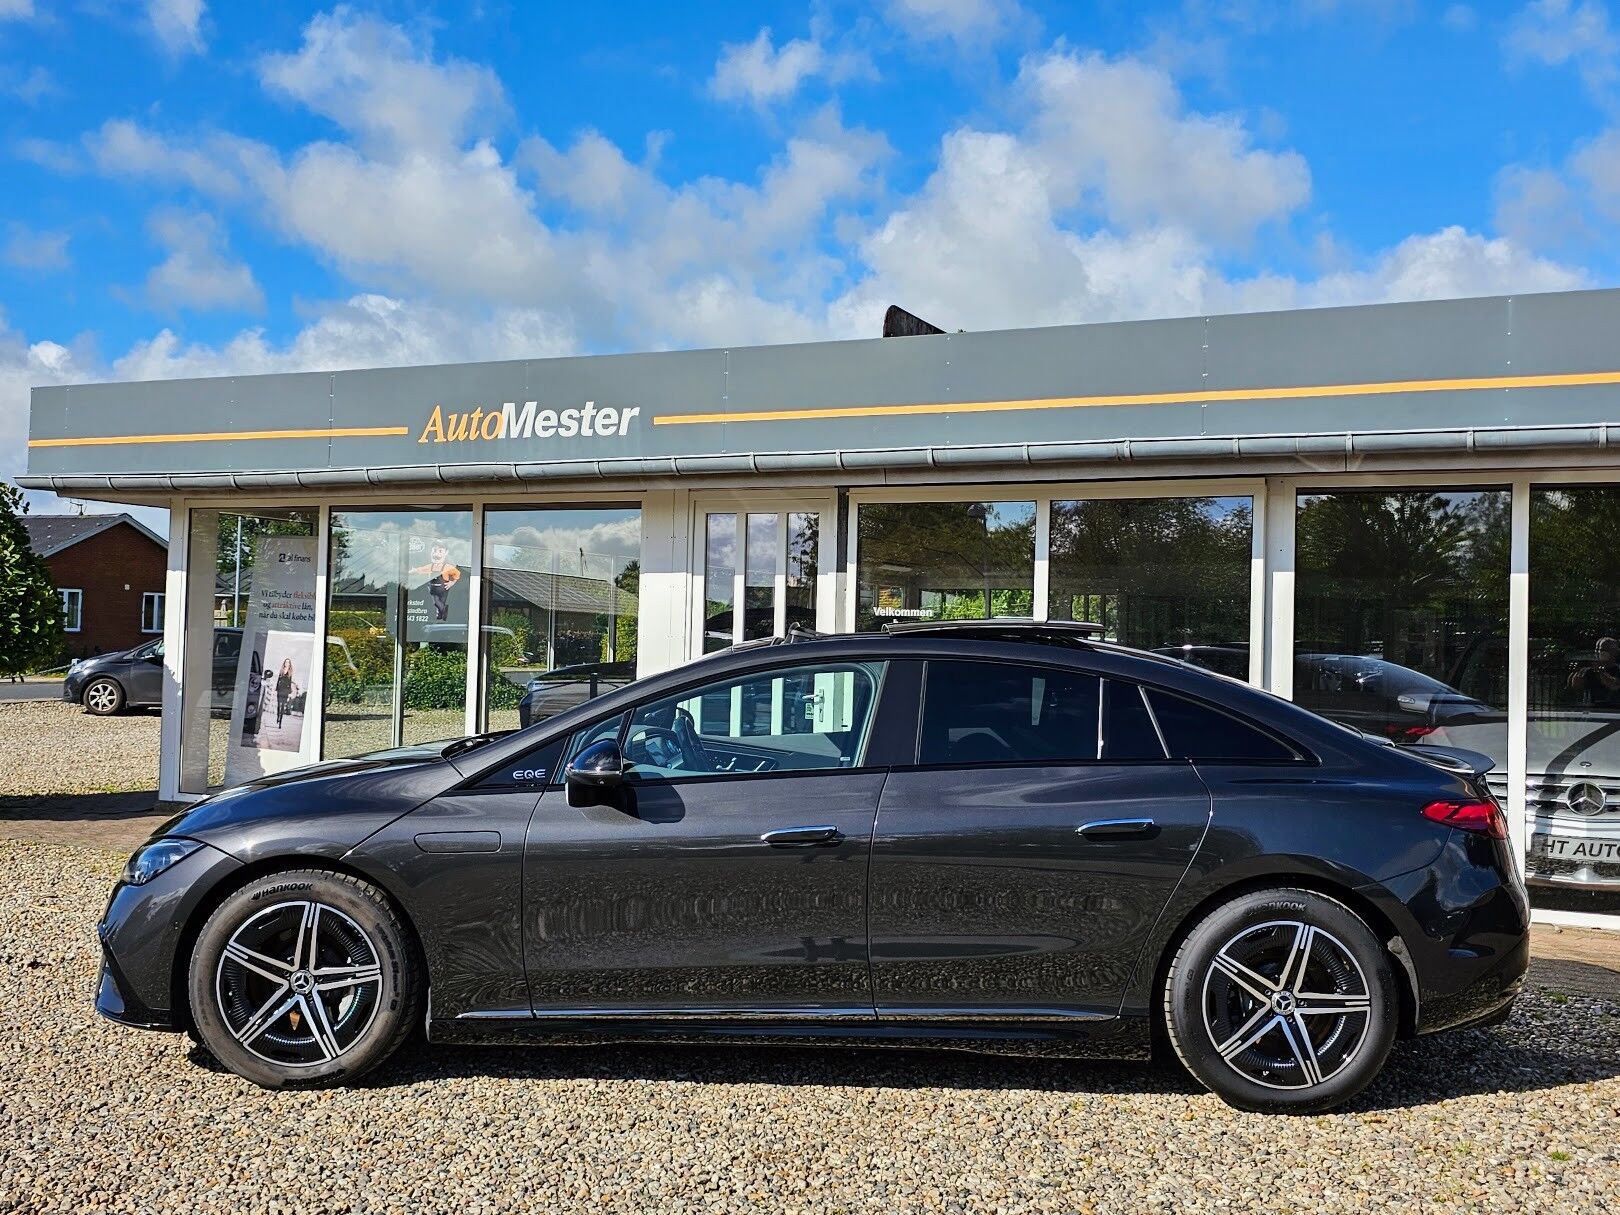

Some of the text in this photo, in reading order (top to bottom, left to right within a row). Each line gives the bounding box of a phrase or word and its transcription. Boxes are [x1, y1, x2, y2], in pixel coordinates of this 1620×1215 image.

[418, 401, 641, 443] AutoMester
[263, 602, 271, 610] og
[270, 611, 277, 619] du
[292, 612, 308, 621] købe
[873, 607, 934, 617] Velkommen
[512, 769, 546, 780] EQE
[1572, 842, 1620, 858] AUT
